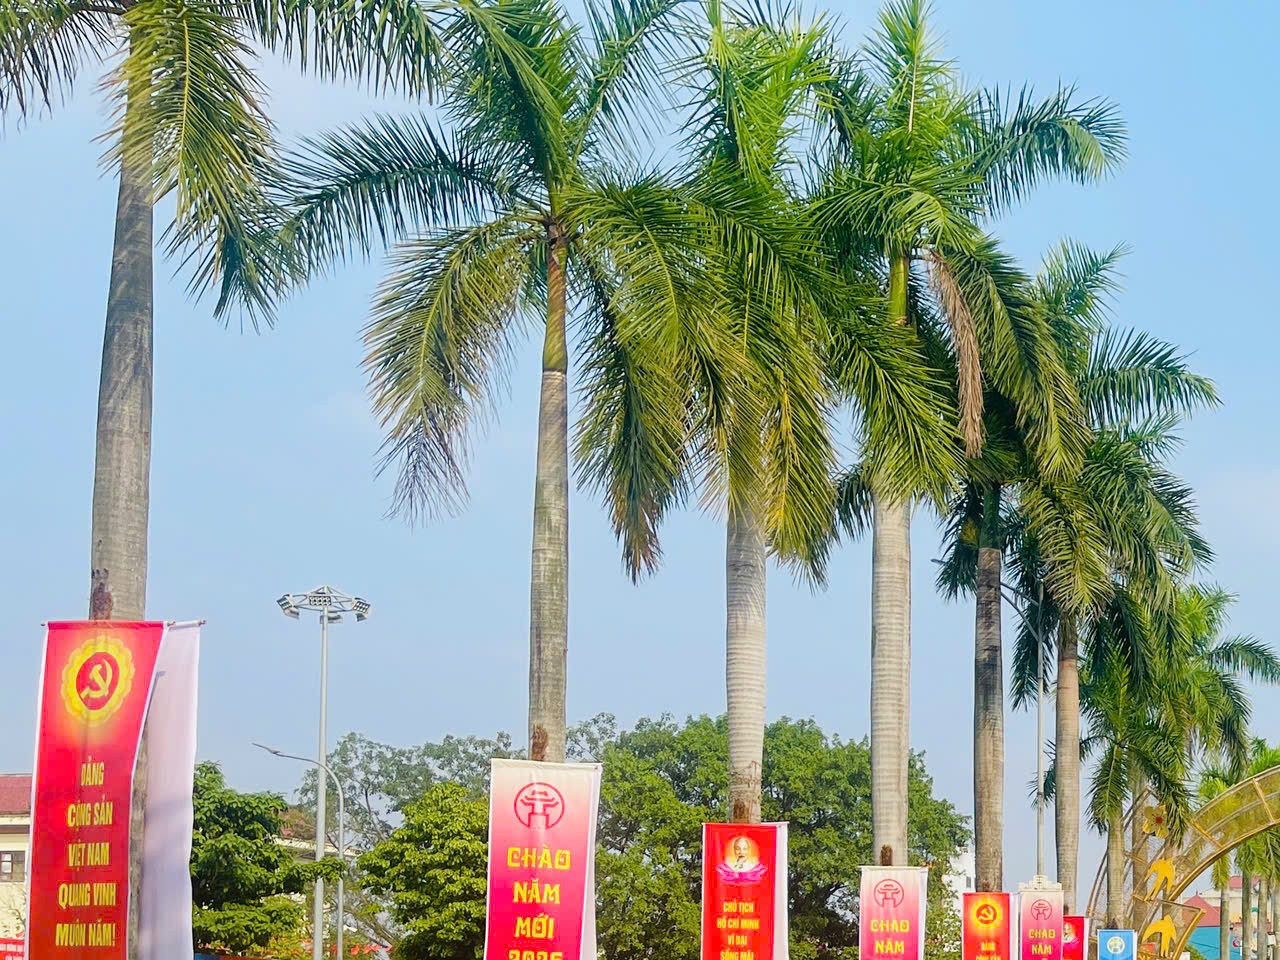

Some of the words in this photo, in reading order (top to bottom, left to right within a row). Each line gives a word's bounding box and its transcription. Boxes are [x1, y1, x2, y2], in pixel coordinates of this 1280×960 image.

[67, 801, 91, 832] CỘNG
[94, 795, 113, 825] SẢN
[68, 839, 86, 871] VIỆT
[87, 842, 109, 865] NAM
[507, 844, 571, 870] CHÀO
[58, 883, 91, 908] QUANG
[93, 883, 116, 906] VINH
[513, 878, 560, 904] NĂM
[55, 919, 86, 946] MUÔN
[88, 918, 116, 947] NĂM!
[514, 913, 555, 938] MỚI
[875, 938, 905, 954] NĂM
